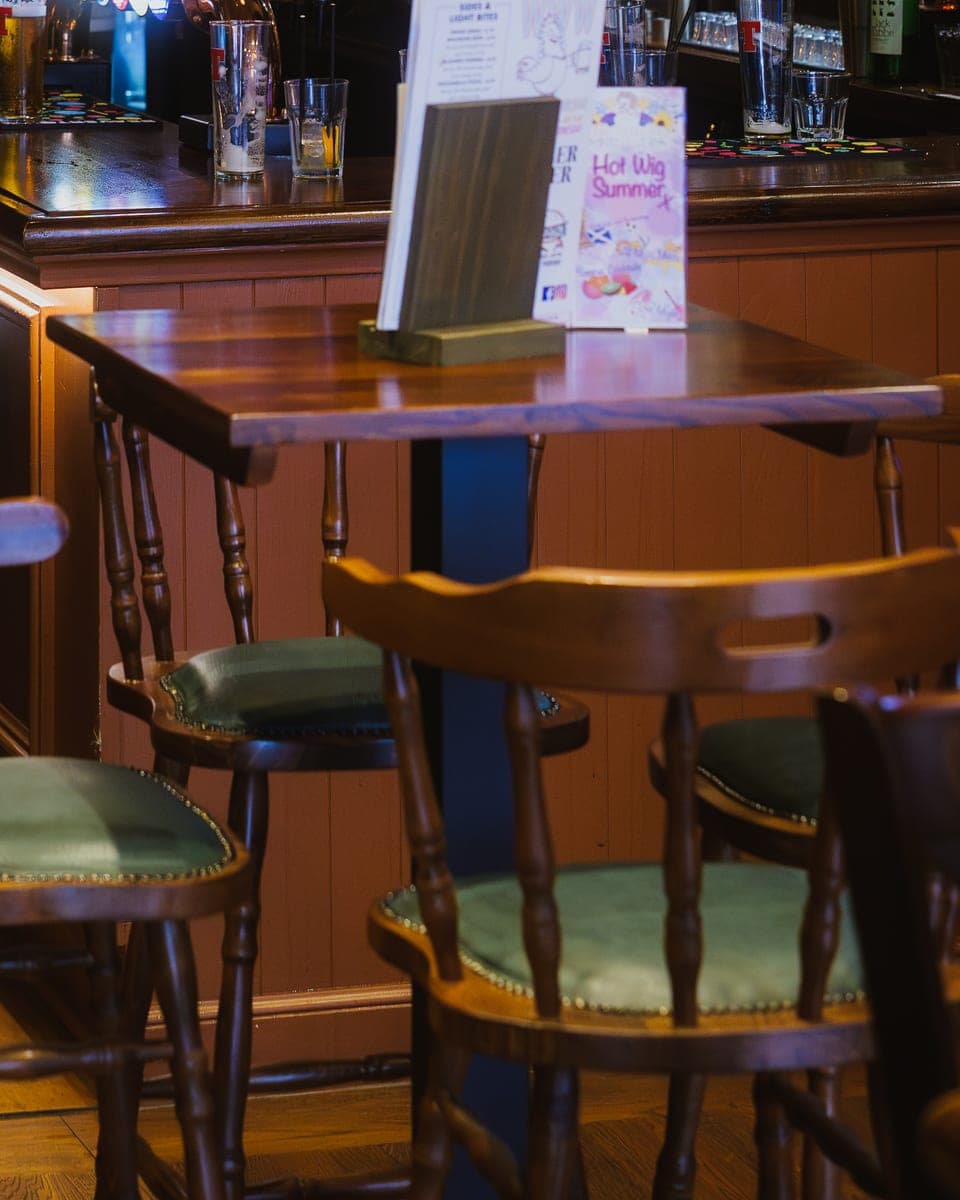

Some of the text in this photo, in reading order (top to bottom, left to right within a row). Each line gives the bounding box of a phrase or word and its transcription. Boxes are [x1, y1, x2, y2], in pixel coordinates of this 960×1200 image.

[741, 20, 761, 53] T
[592, 153, 666, 182] Hot Wig
[592, 175, 666, 199] Summer
